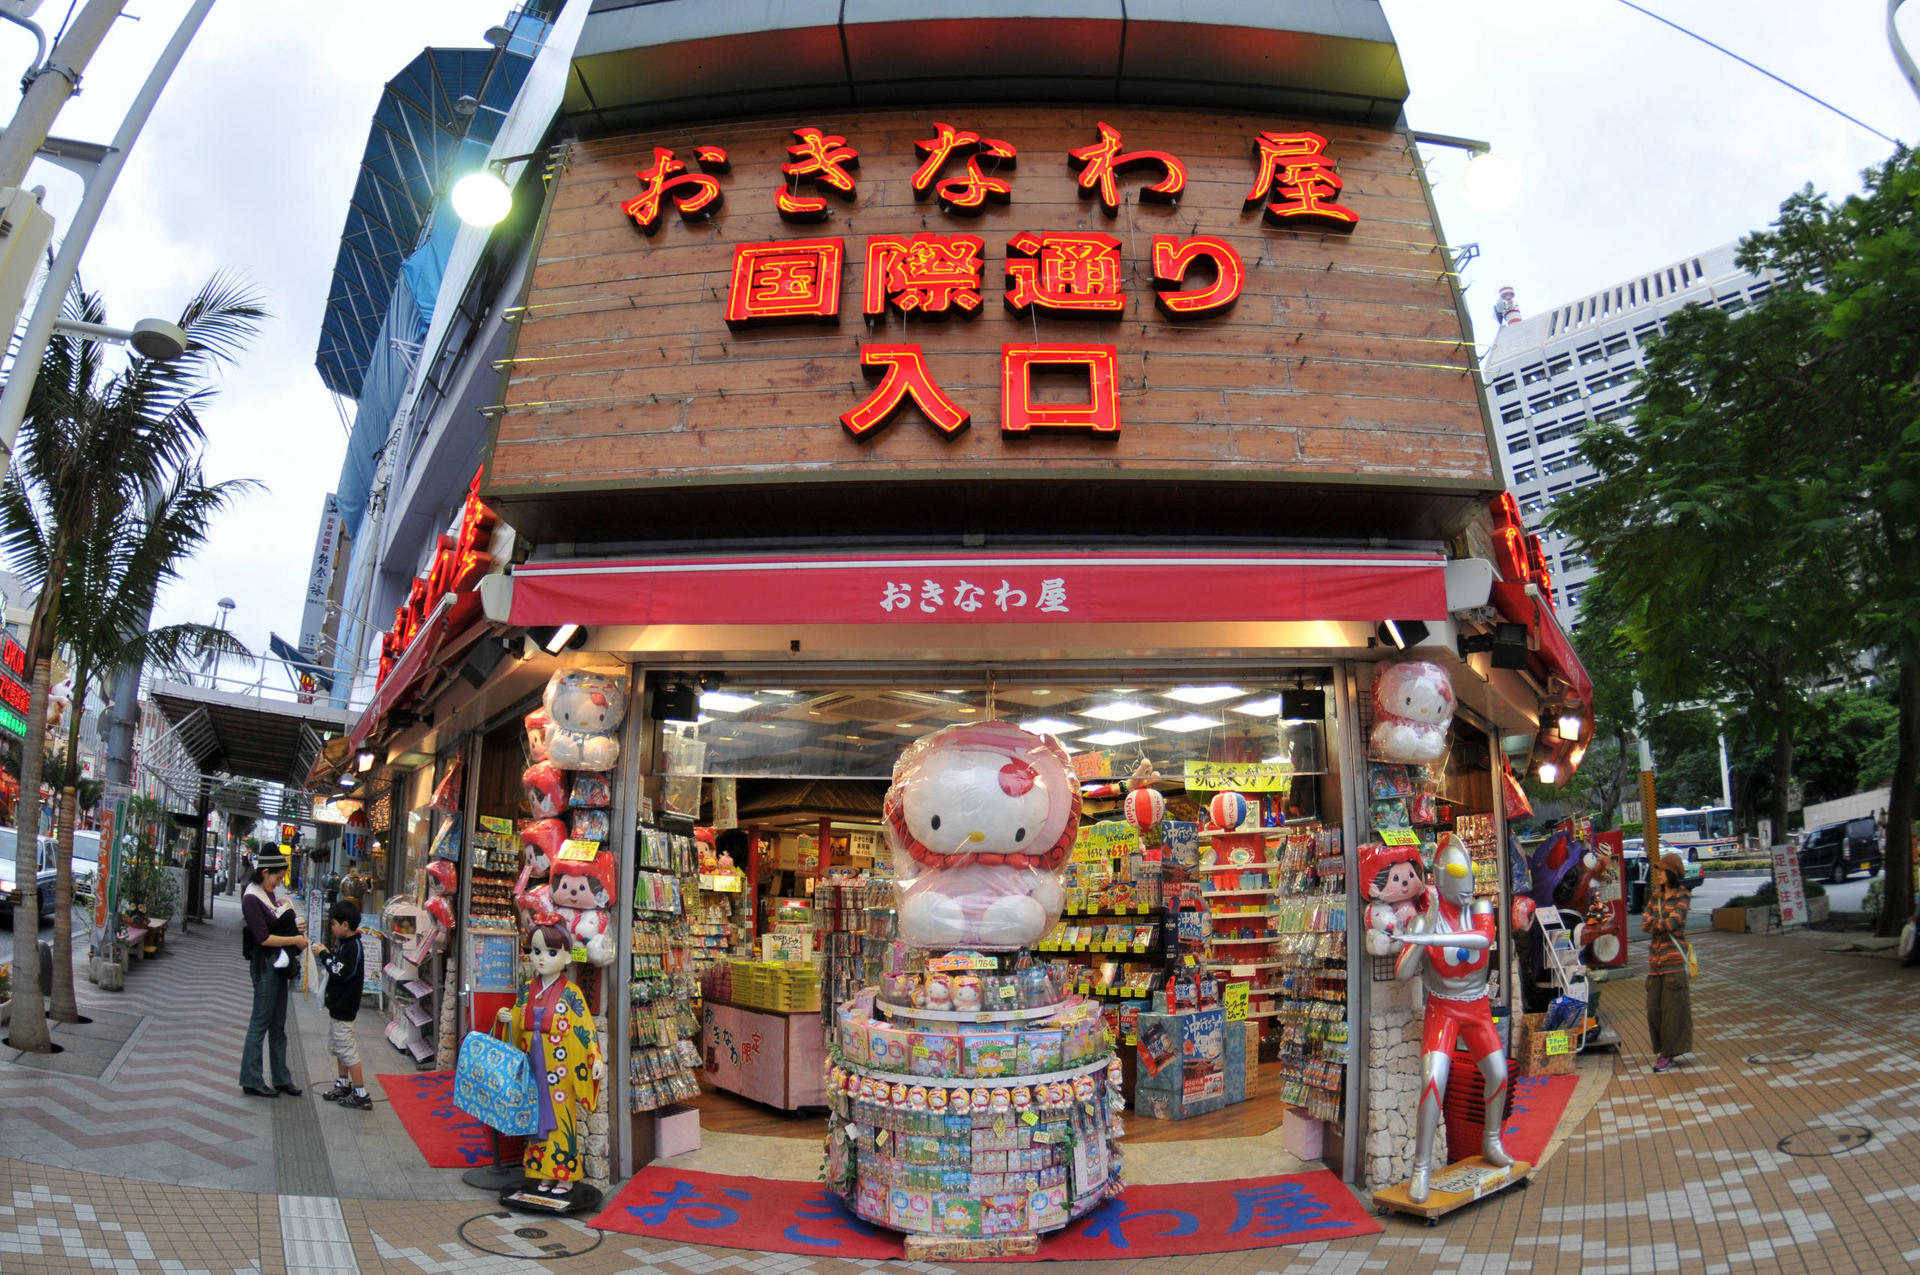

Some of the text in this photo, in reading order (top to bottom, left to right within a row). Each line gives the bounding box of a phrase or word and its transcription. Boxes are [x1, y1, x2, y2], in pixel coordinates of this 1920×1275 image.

[620, 121, 1359, 236] おきなわ屋
[725, 231, 1246, 331] 国際通り
[840, 343, 1122, 442] 入口
[879, 577, 1070, 613] おきなわ屋
[1775, 854, 1794, 920] 足元注意
